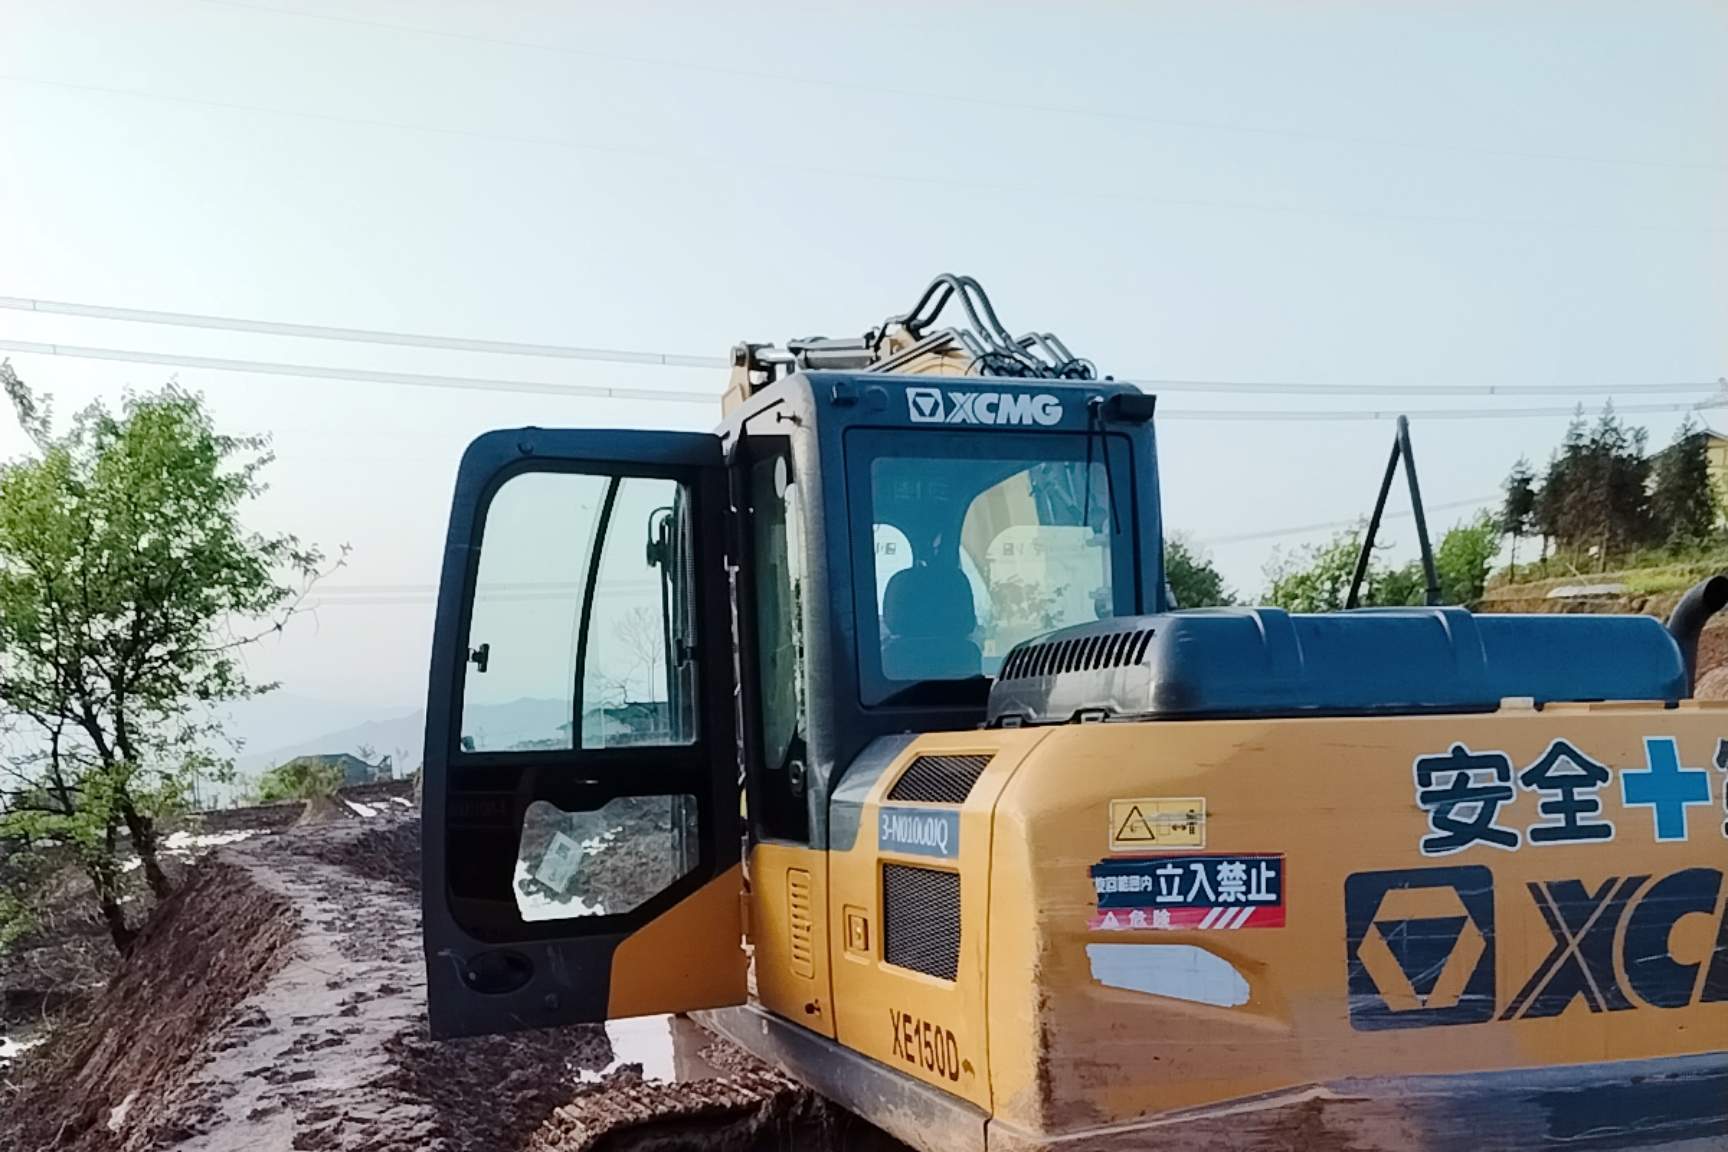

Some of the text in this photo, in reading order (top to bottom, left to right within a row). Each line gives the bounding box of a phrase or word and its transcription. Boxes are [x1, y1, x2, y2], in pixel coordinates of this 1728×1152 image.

[945, 392, 1064, 426] XCMG
[1155, 861, 1277, 902] 立入禁止
[1497, 866, 1728, 1021] XC
[889, 1008, 960, 1082] XE150D
